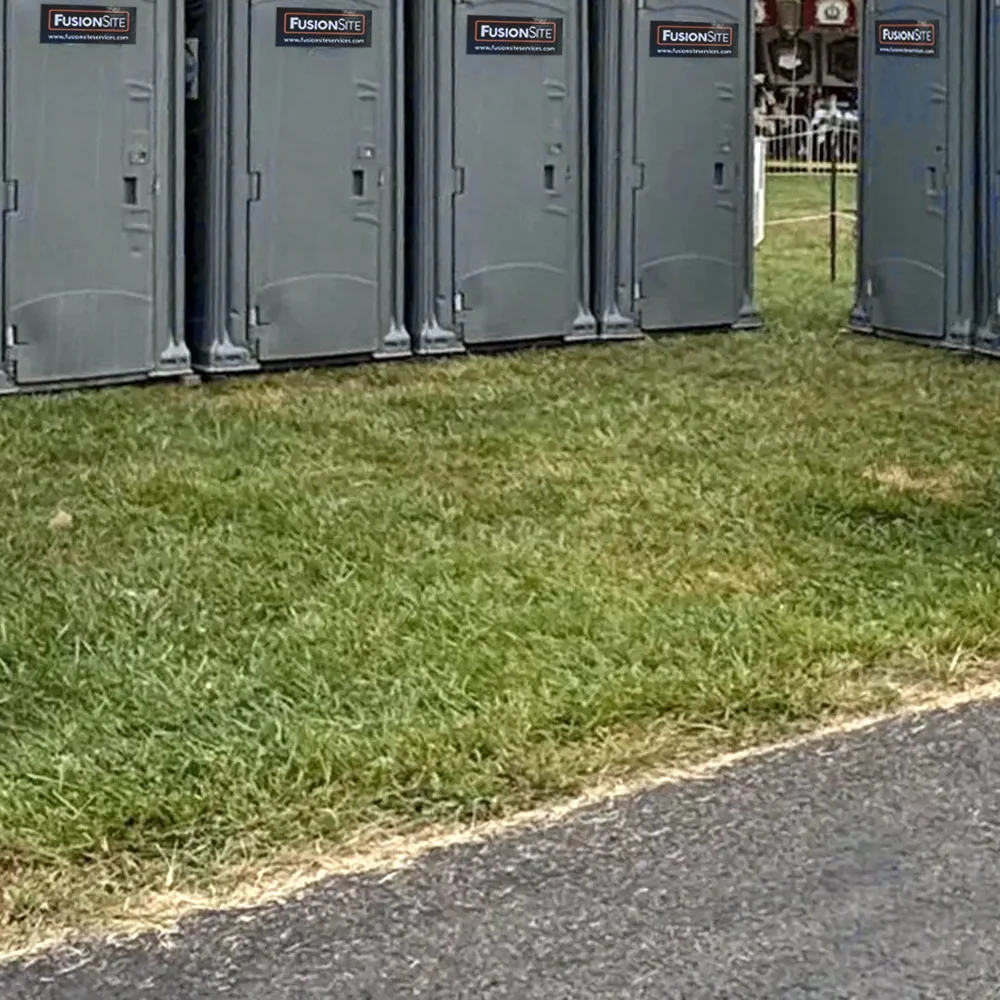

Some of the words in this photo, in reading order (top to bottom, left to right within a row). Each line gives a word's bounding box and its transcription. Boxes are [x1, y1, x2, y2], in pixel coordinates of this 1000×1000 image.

[54, 14, 126, 29] FUSIONSITE
[290, 17, 362, 31] FUSIONSITE
[481, 25, 552, 39] FUSIONSITE
[662, 30, 729, 43] FUSIONSITE
[882, 28, 932, 42] FUSIONSITE
